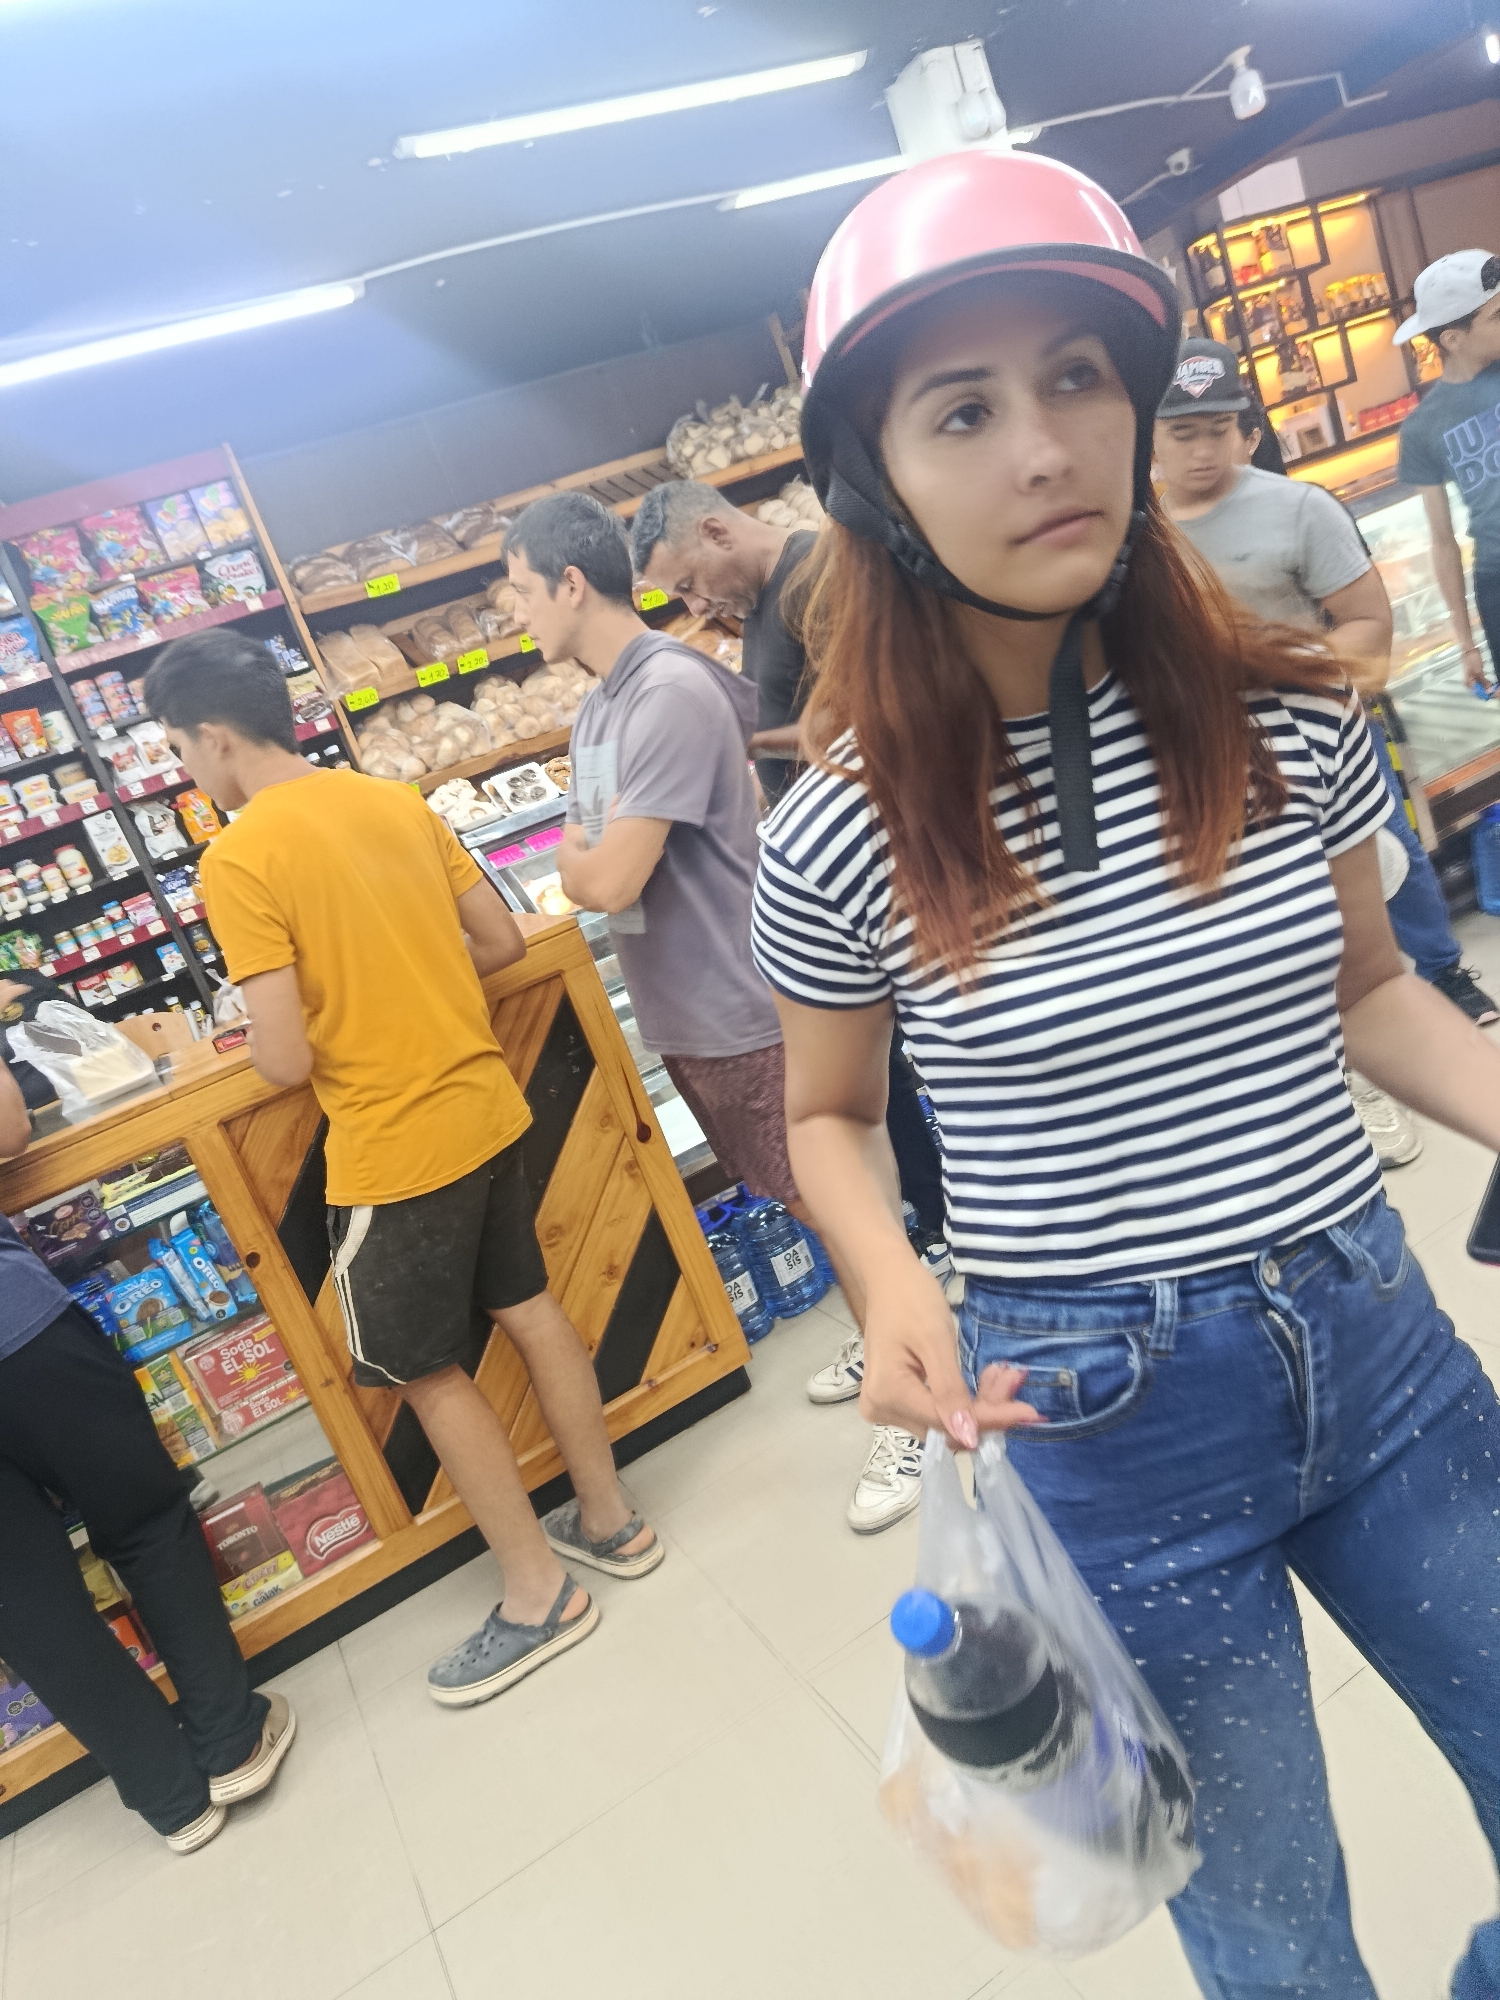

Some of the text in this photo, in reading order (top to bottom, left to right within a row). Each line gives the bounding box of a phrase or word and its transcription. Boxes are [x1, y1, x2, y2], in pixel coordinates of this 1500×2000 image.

[784, 1249, 799, 1262] OA
[787, 1256, 802, 1270] SIS
[193, 1256, 220, 1289] OREO
[114, 1279, 162, 1315] OREO
[220, 1338, 254, 1360] Soda
[221, 1356, 244, 1375] EL
[243, 1340, 275, 1363] SOL
[249, 1396, 270, 1409] Soda
[251, 1397, 285, 1418] EL SOL
[216, 1525, 258, 1551] TORONTO
[252, 1584, 283, 1607] Galak
